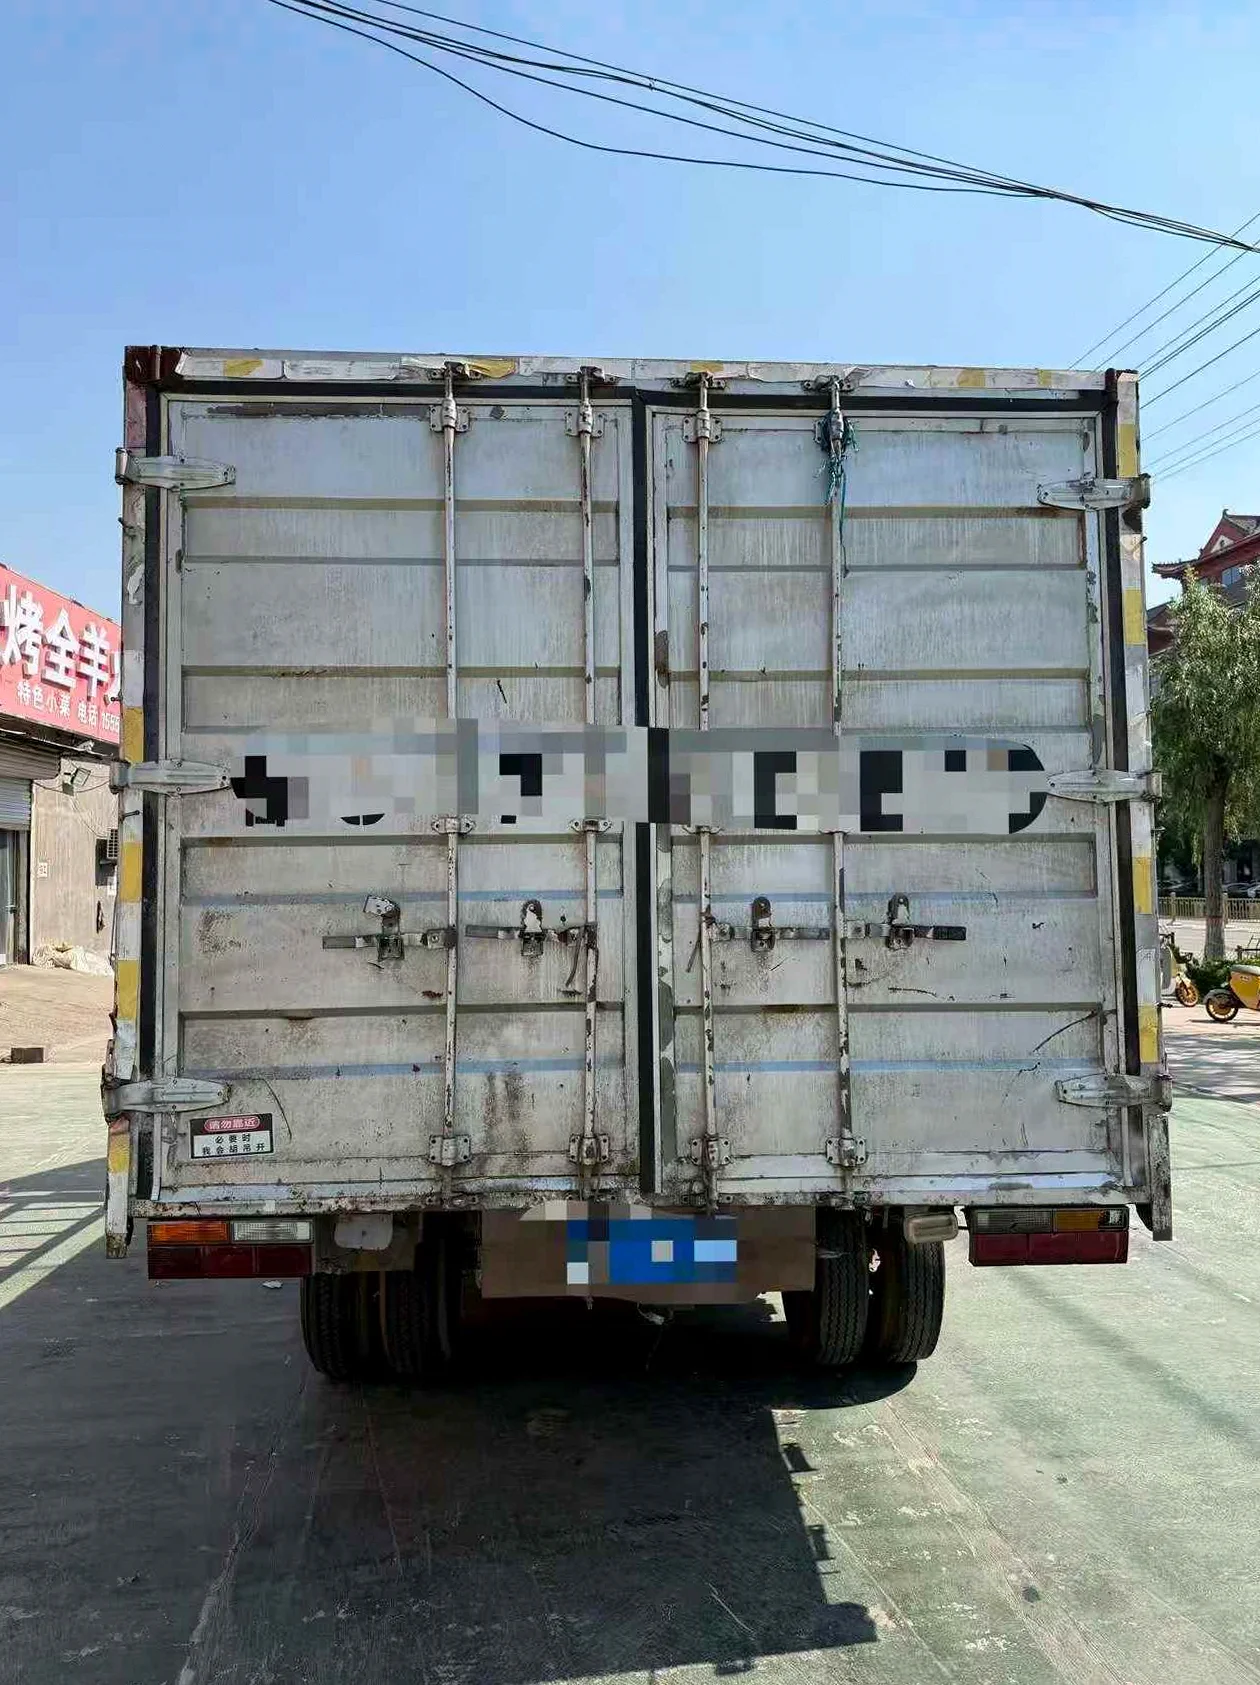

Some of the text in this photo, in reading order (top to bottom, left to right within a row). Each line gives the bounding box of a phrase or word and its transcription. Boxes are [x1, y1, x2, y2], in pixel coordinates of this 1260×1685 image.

[77, 701, 98, 728] 电话
[214, 1133, 251, 1144] 必要时
